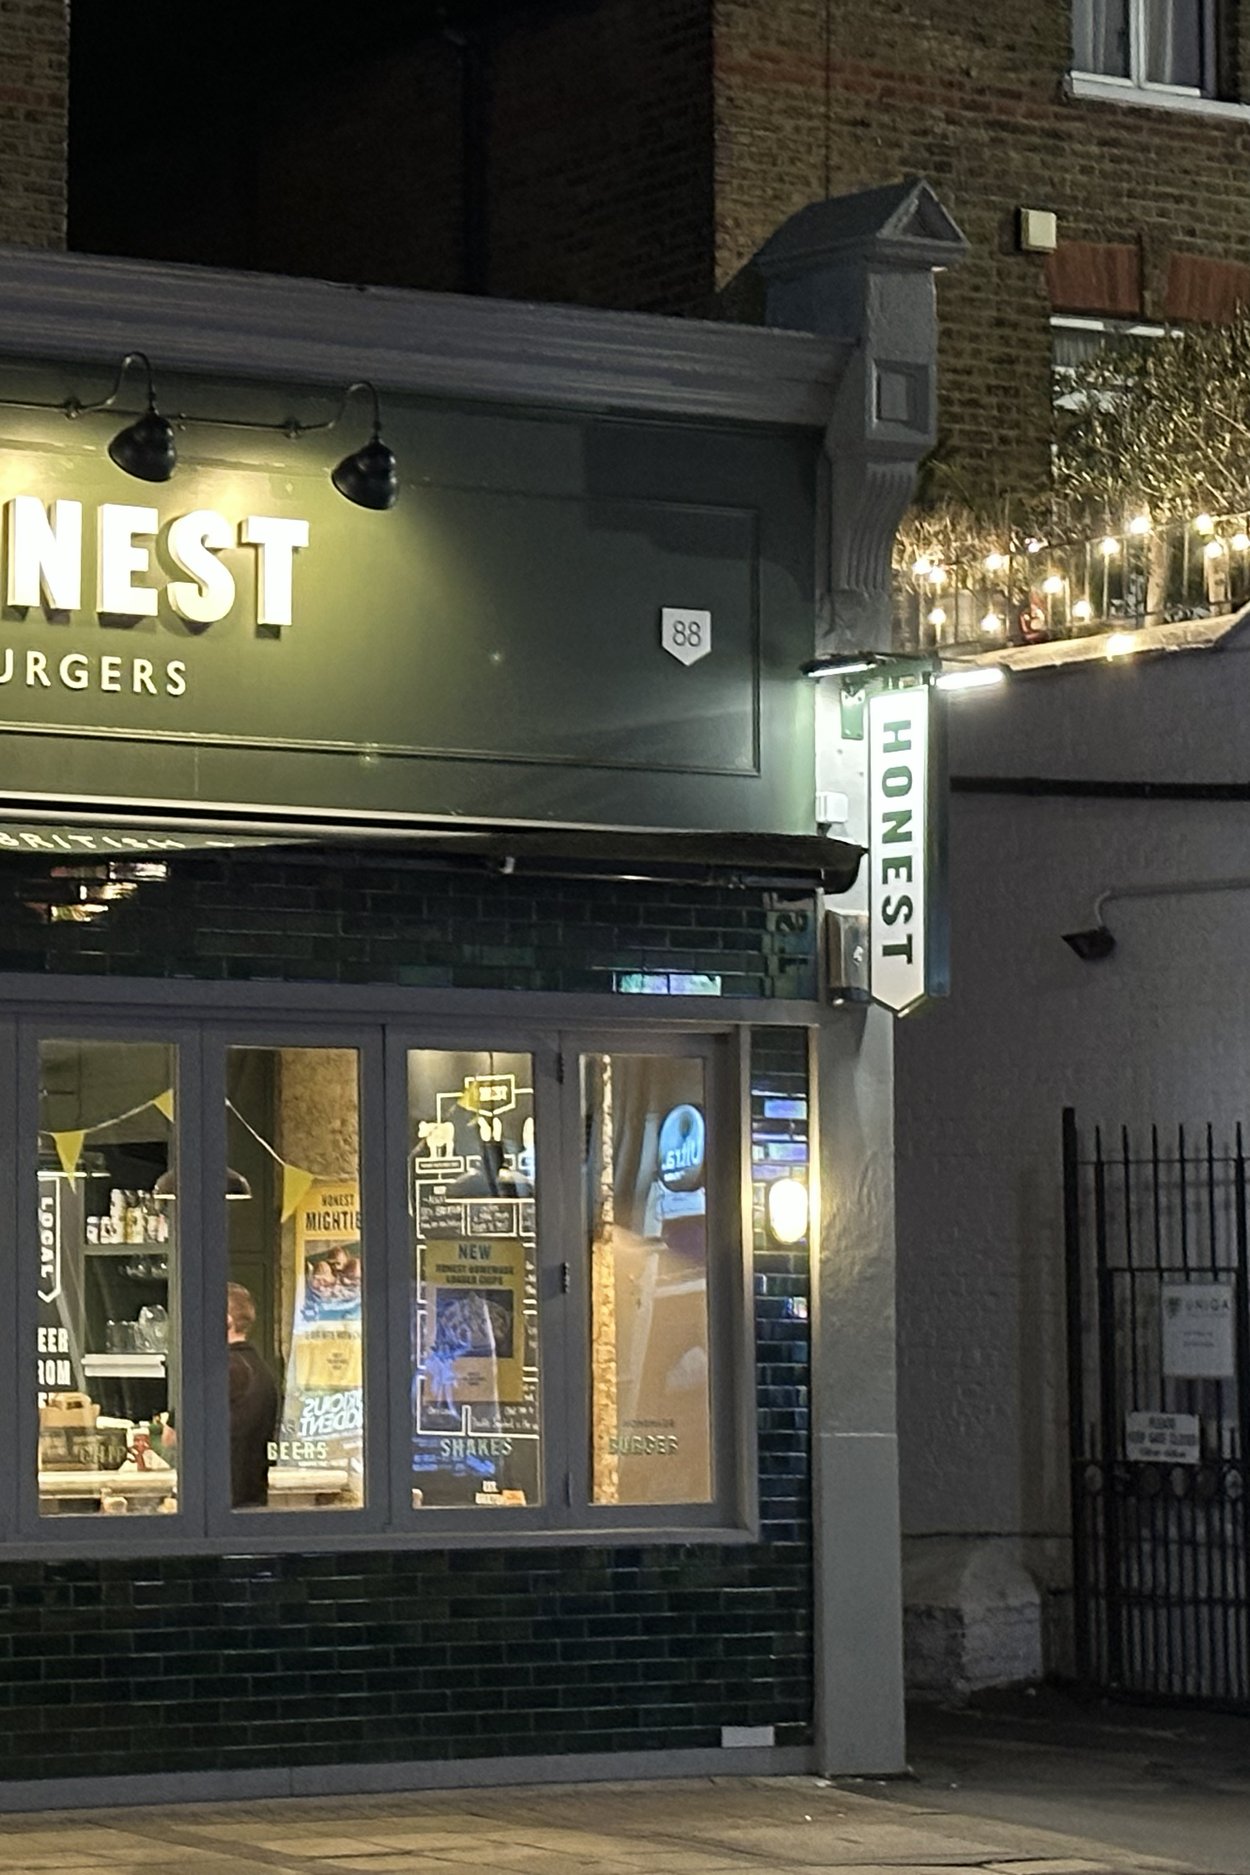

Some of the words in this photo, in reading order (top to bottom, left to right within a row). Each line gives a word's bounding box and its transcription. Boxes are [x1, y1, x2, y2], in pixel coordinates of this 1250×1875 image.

[672, 620, 701, 647] 88
[881, 719, 914, 965] HONEST
[321, 1193, 354, 1207] HONEST
[40, 1197, 55, 1279] LOCAL
[458, 1244, 491, 1261] NEW
[267, 1441, 327, 1460] BEERS
[440, 1438, 513, 1457] SHAKES
